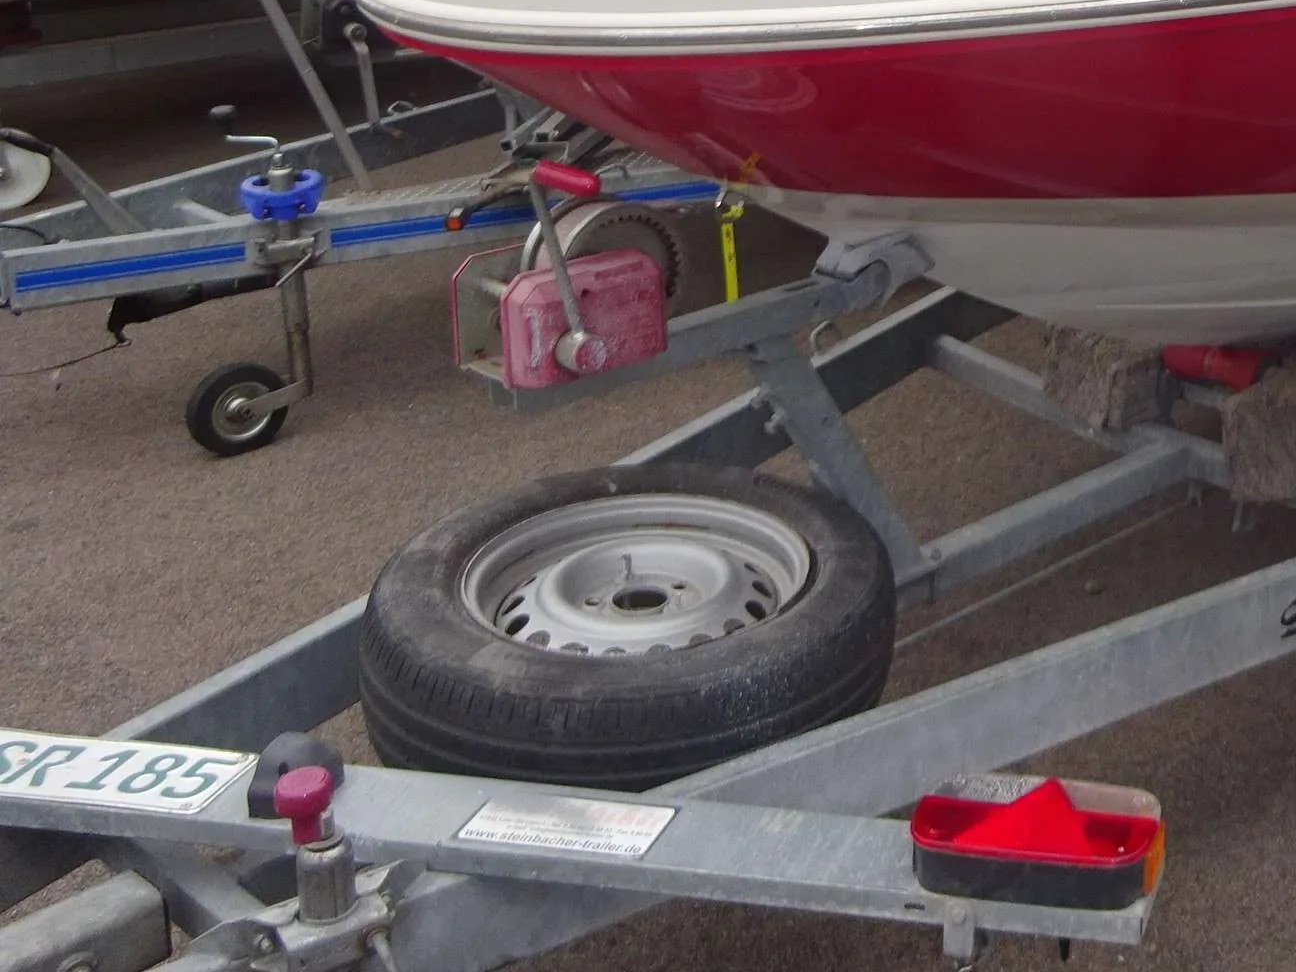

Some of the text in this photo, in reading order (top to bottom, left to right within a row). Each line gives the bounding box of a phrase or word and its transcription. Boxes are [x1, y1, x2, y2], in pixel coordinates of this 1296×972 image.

[0, 740, 239, 799] SR 185
[463, 828, 643, 854] www.steinbacher-trailer.de
